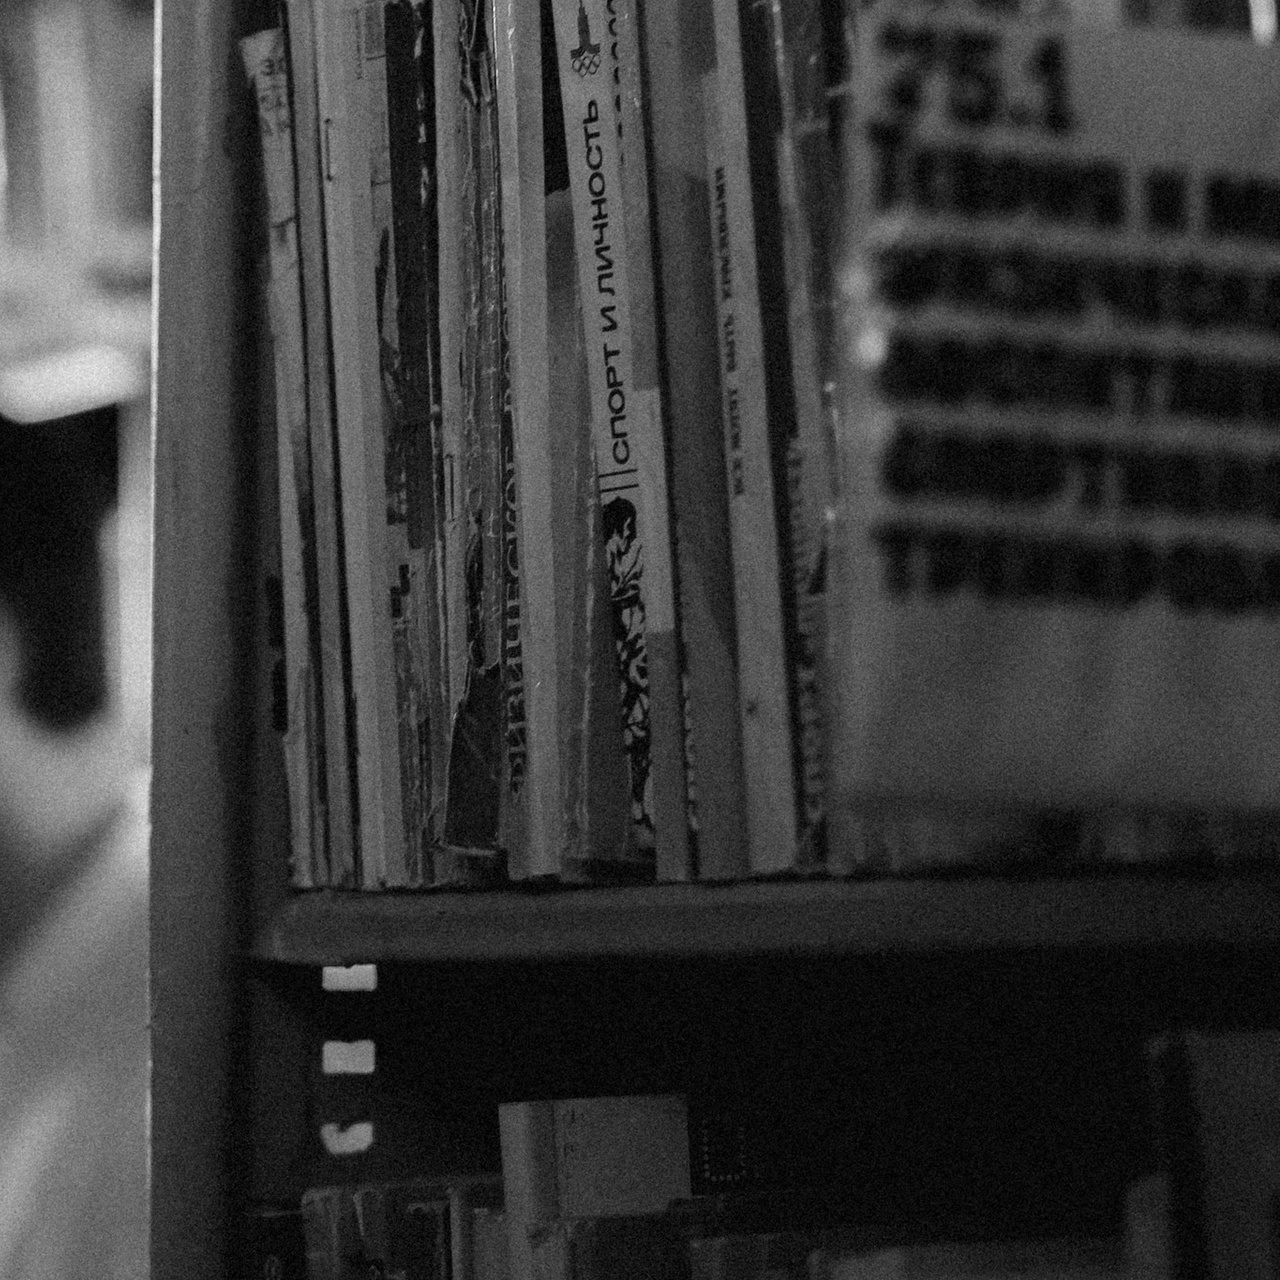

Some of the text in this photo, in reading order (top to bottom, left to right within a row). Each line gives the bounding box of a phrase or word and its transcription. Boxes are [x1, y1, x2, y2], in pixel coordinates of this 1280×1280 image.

[583, 99, 630, 465] СПОРТ И ЛИЧНОСТЬ
